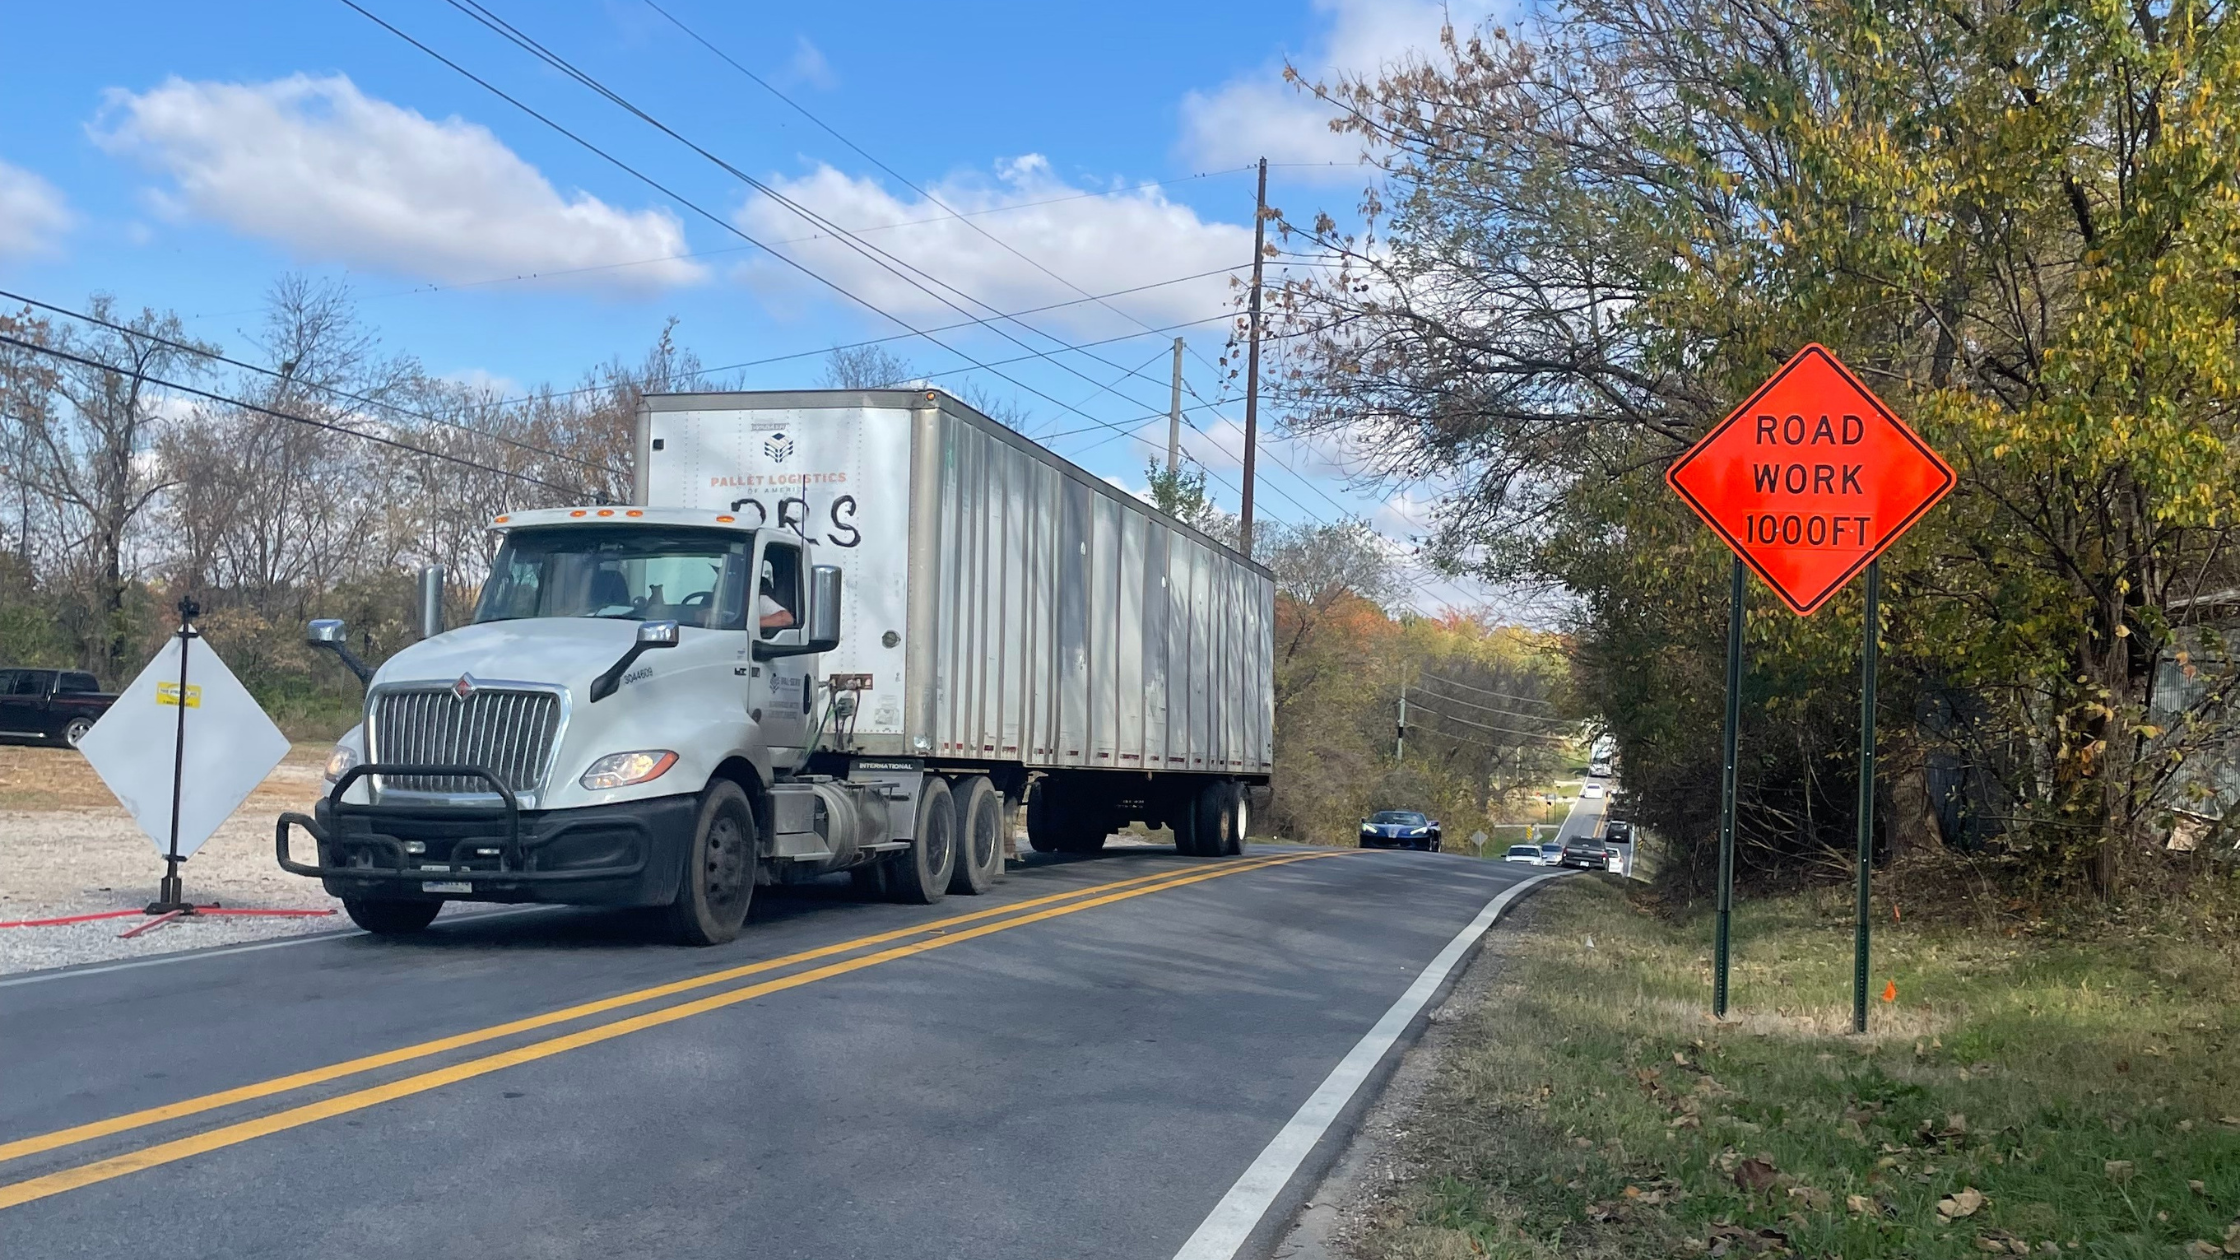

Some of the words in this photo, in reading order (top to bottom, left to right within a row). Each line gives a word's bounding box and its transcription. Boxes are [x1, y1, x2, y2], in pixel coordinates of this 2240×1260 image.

[1756, 415, 1865, 446] ROAD
[711, 474, 764, 487] PALLET
[769, 472, 846, 485] LOGISTICS
[1753, 464, 1864, 495] WORK
[764, 486, 808, 494] AMERICA
[1746, 515, 1871, 546] 1000FT
[624, 666, 654, 684] 3044609
[859, 762, 913, 770] INTERNATIONAL
